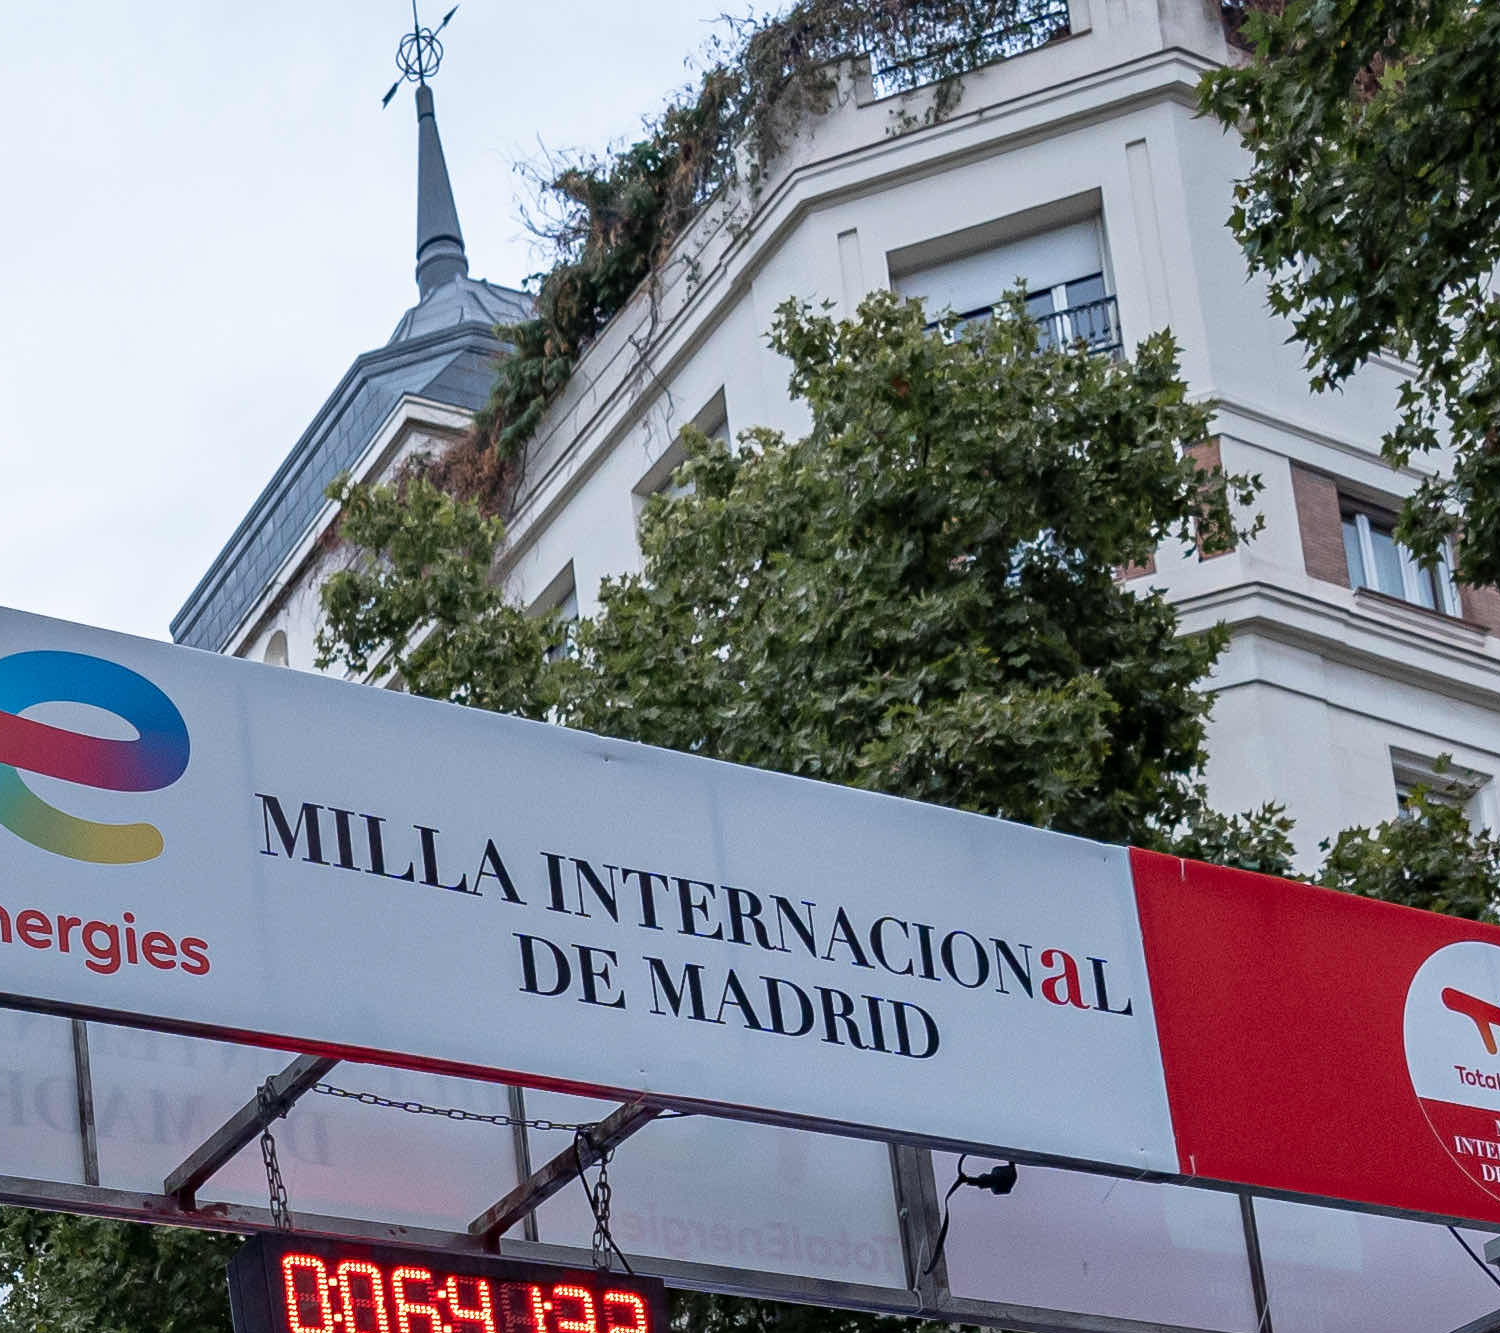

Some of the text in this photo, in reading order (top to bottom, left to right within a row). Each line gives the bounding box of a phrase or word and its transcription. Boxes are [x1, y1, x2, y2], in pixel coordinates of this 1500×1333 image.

[254, 790, 527, 908] MILLA
[517, 931, 941, 1062] DE MADRID
